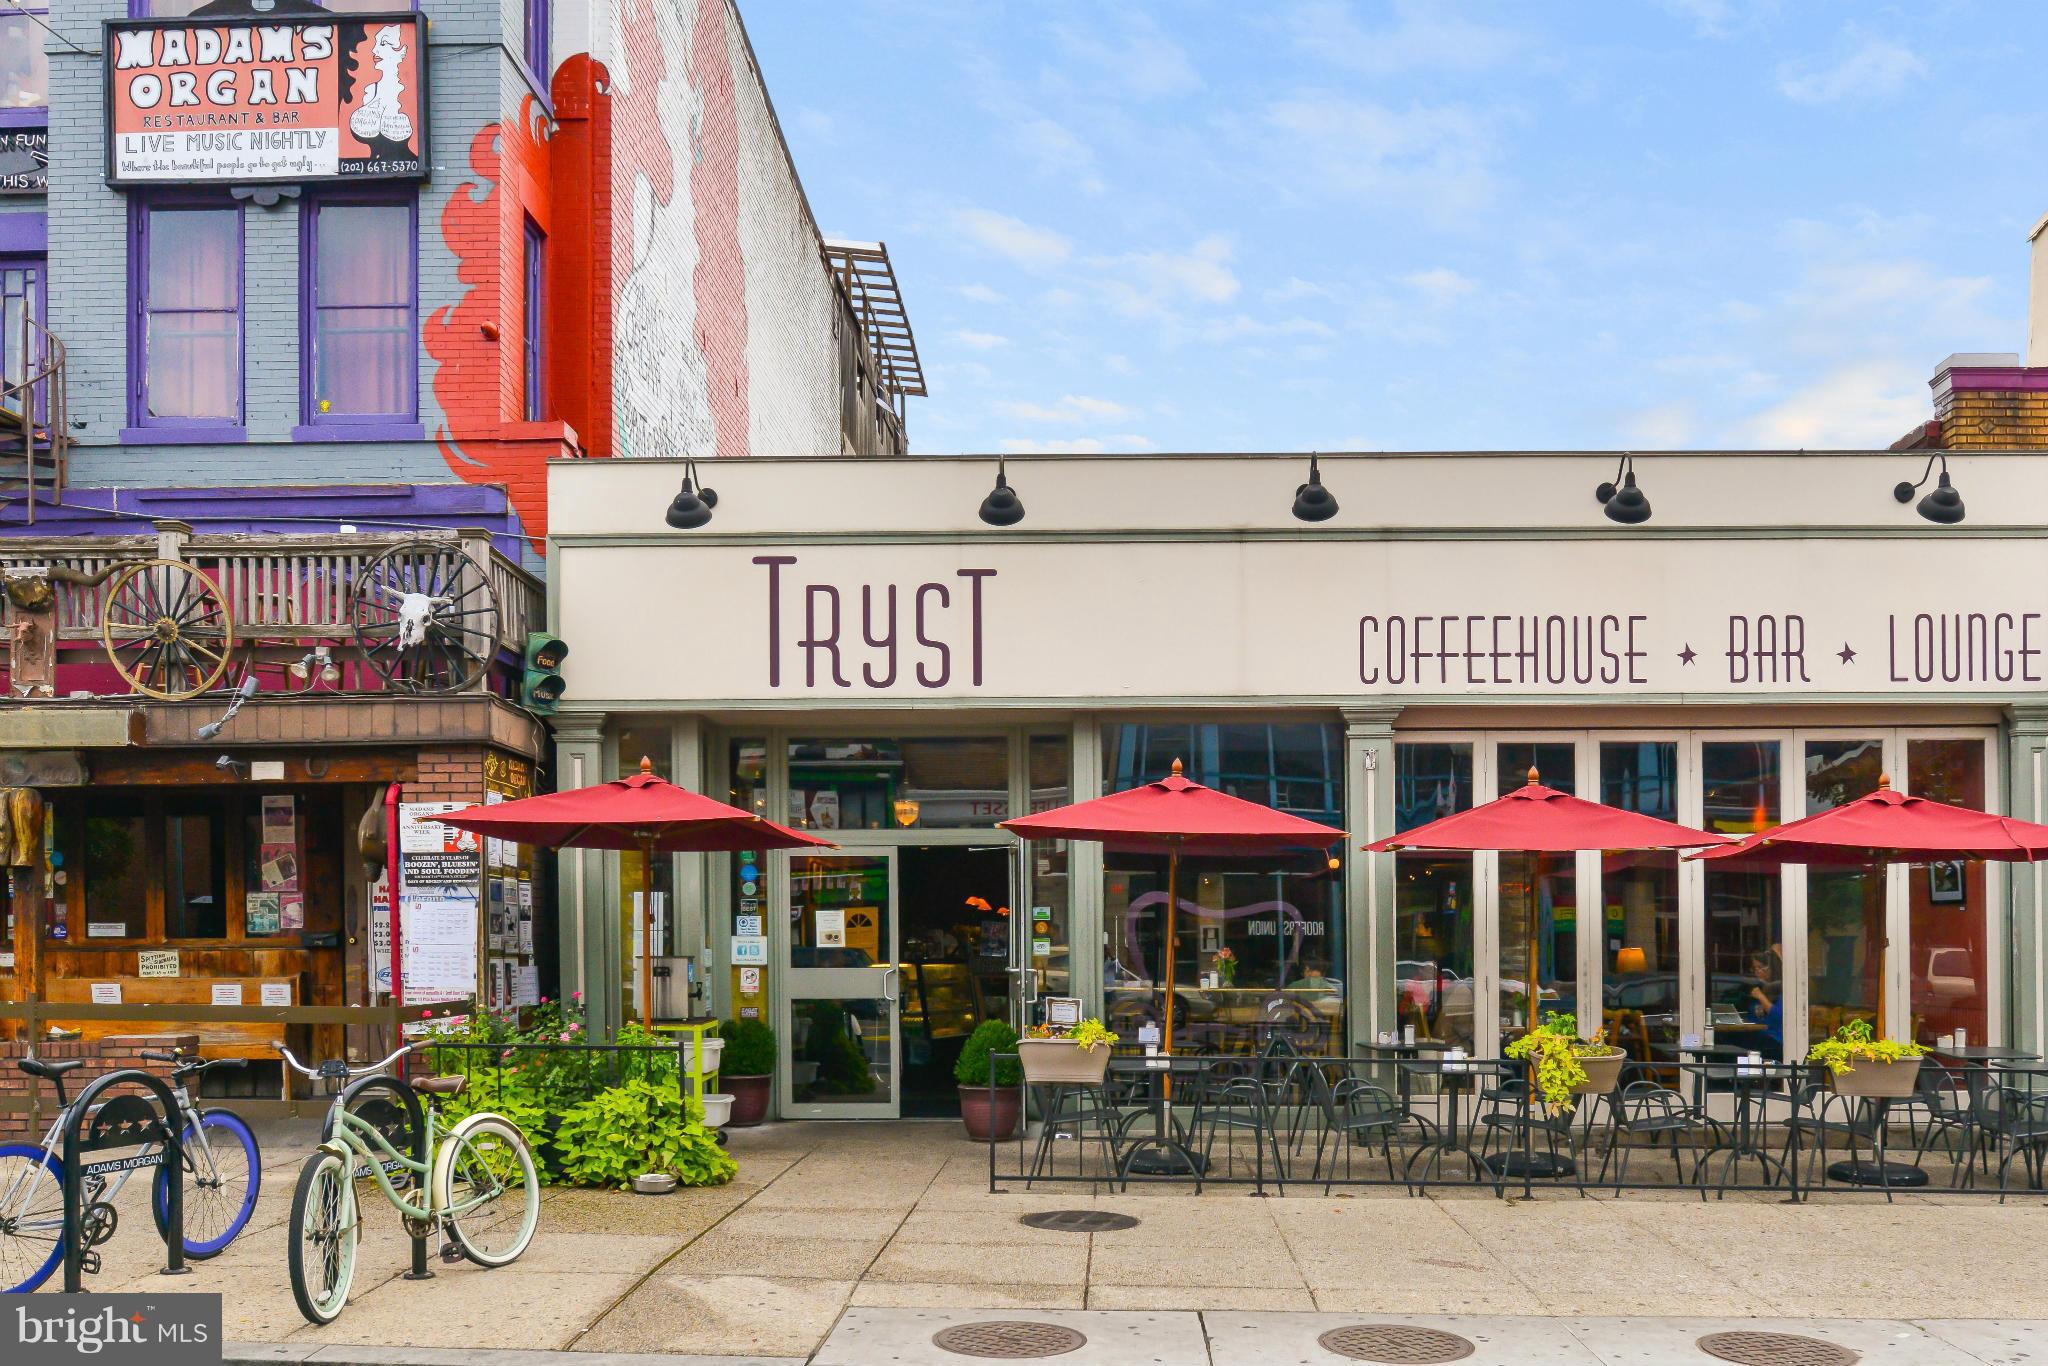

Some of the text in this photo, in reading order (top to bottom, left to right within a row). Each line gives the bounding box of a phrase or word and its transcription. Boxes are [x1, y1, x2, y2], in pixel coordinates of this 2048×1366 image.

[116, 25, 334, 70] MADAM'S
[129, 67, 320, 109] ORGAN
[143, 111, 300, 128] RESTAURANT & BAR
[125, 130, 327, 153] LIVE MUSIC NIGHTLY
[121, 160, 151, 171] Where
[171, 158, 214, 172] beautiful
[216, 156, 245, 174] people
[341, 161, 418, 173] (202) 667-5370
[752, 555, 998, 689] TRYST
[1359, 612, 2042, 685] COFFEEHOUSE BAR LOUNGE
[86, 1154, 163, 1175] ADAMS MORGAN
